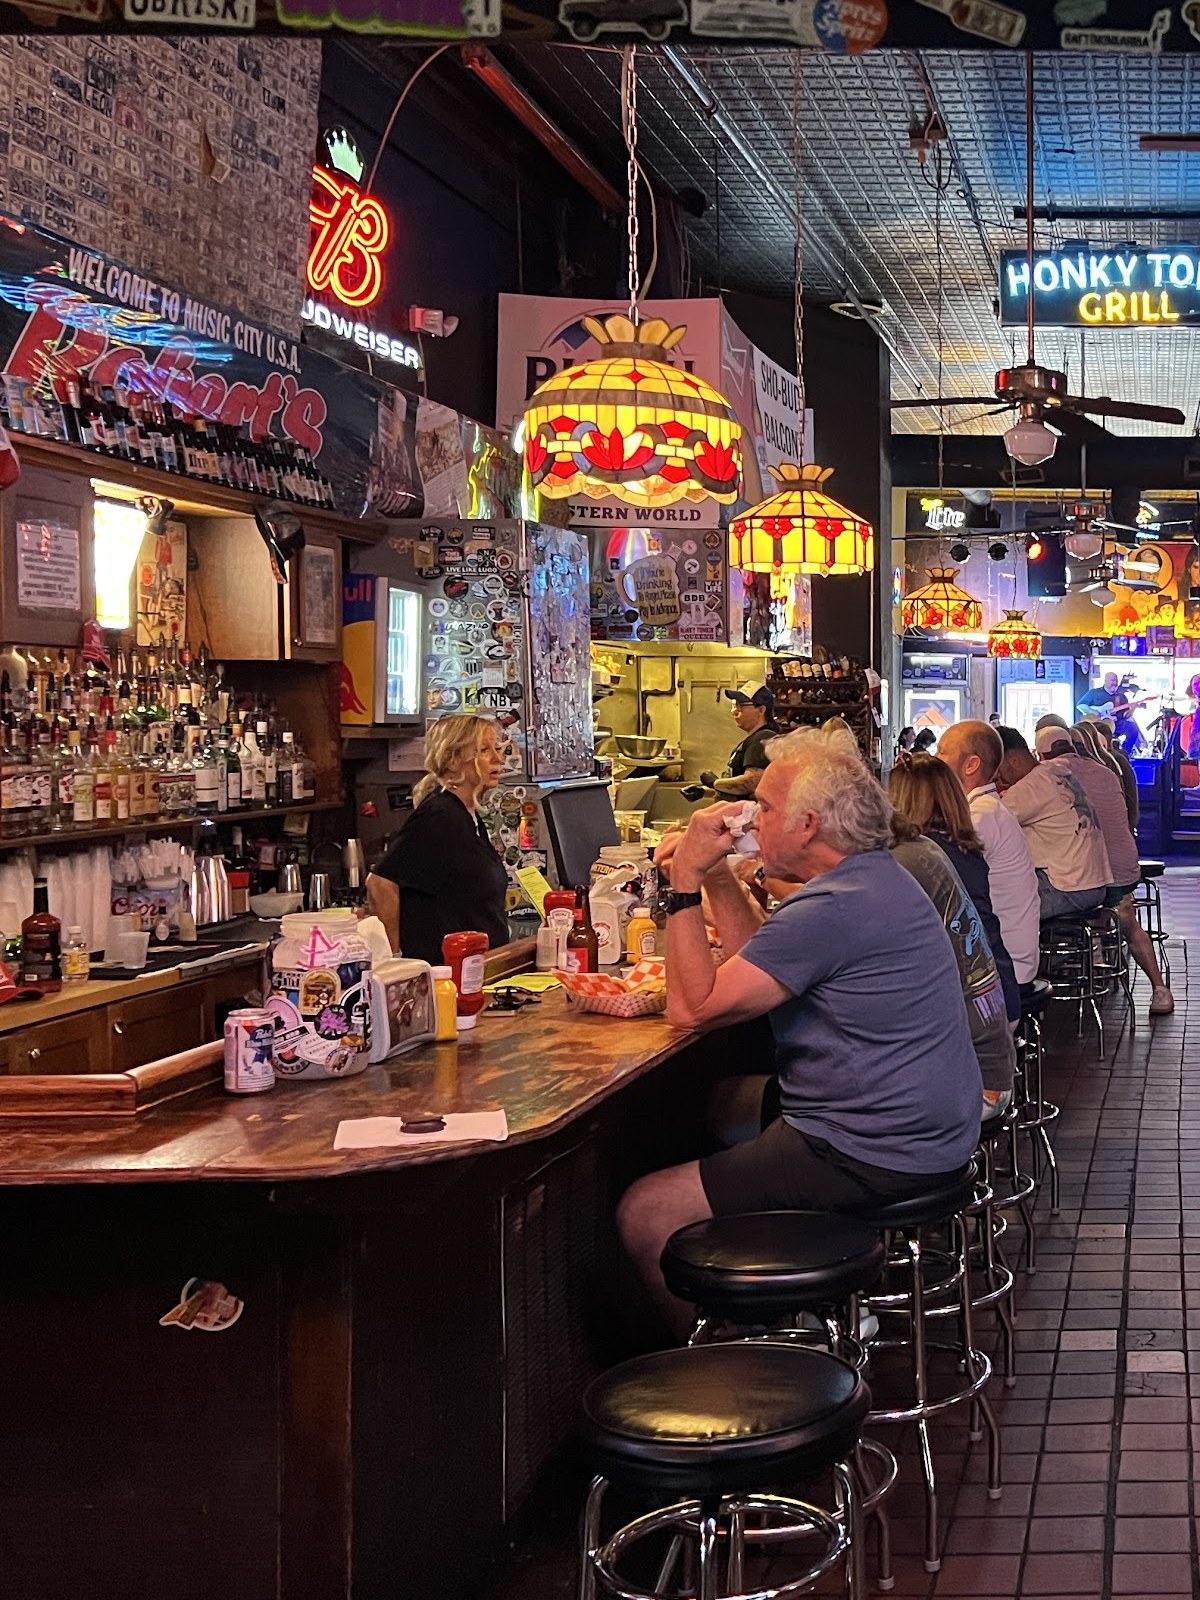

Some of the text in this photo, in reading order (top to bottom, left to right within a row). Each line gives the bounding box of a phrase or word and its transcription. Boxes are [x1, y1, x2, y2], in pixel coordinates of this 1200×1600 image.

[1006, 254, 1138, 296] HONKY
[67, 247, 303, 374] WELCOME TO MUSIC CITY U.S.A.
[1079, 290, 1180, 322] GRILL
[764, 411, 799, 461] BALCON
[635, 507, 702, 522] WORLD
[636, 579, 673, 590] Drinking
[684, 594, 706, 602] BDB
